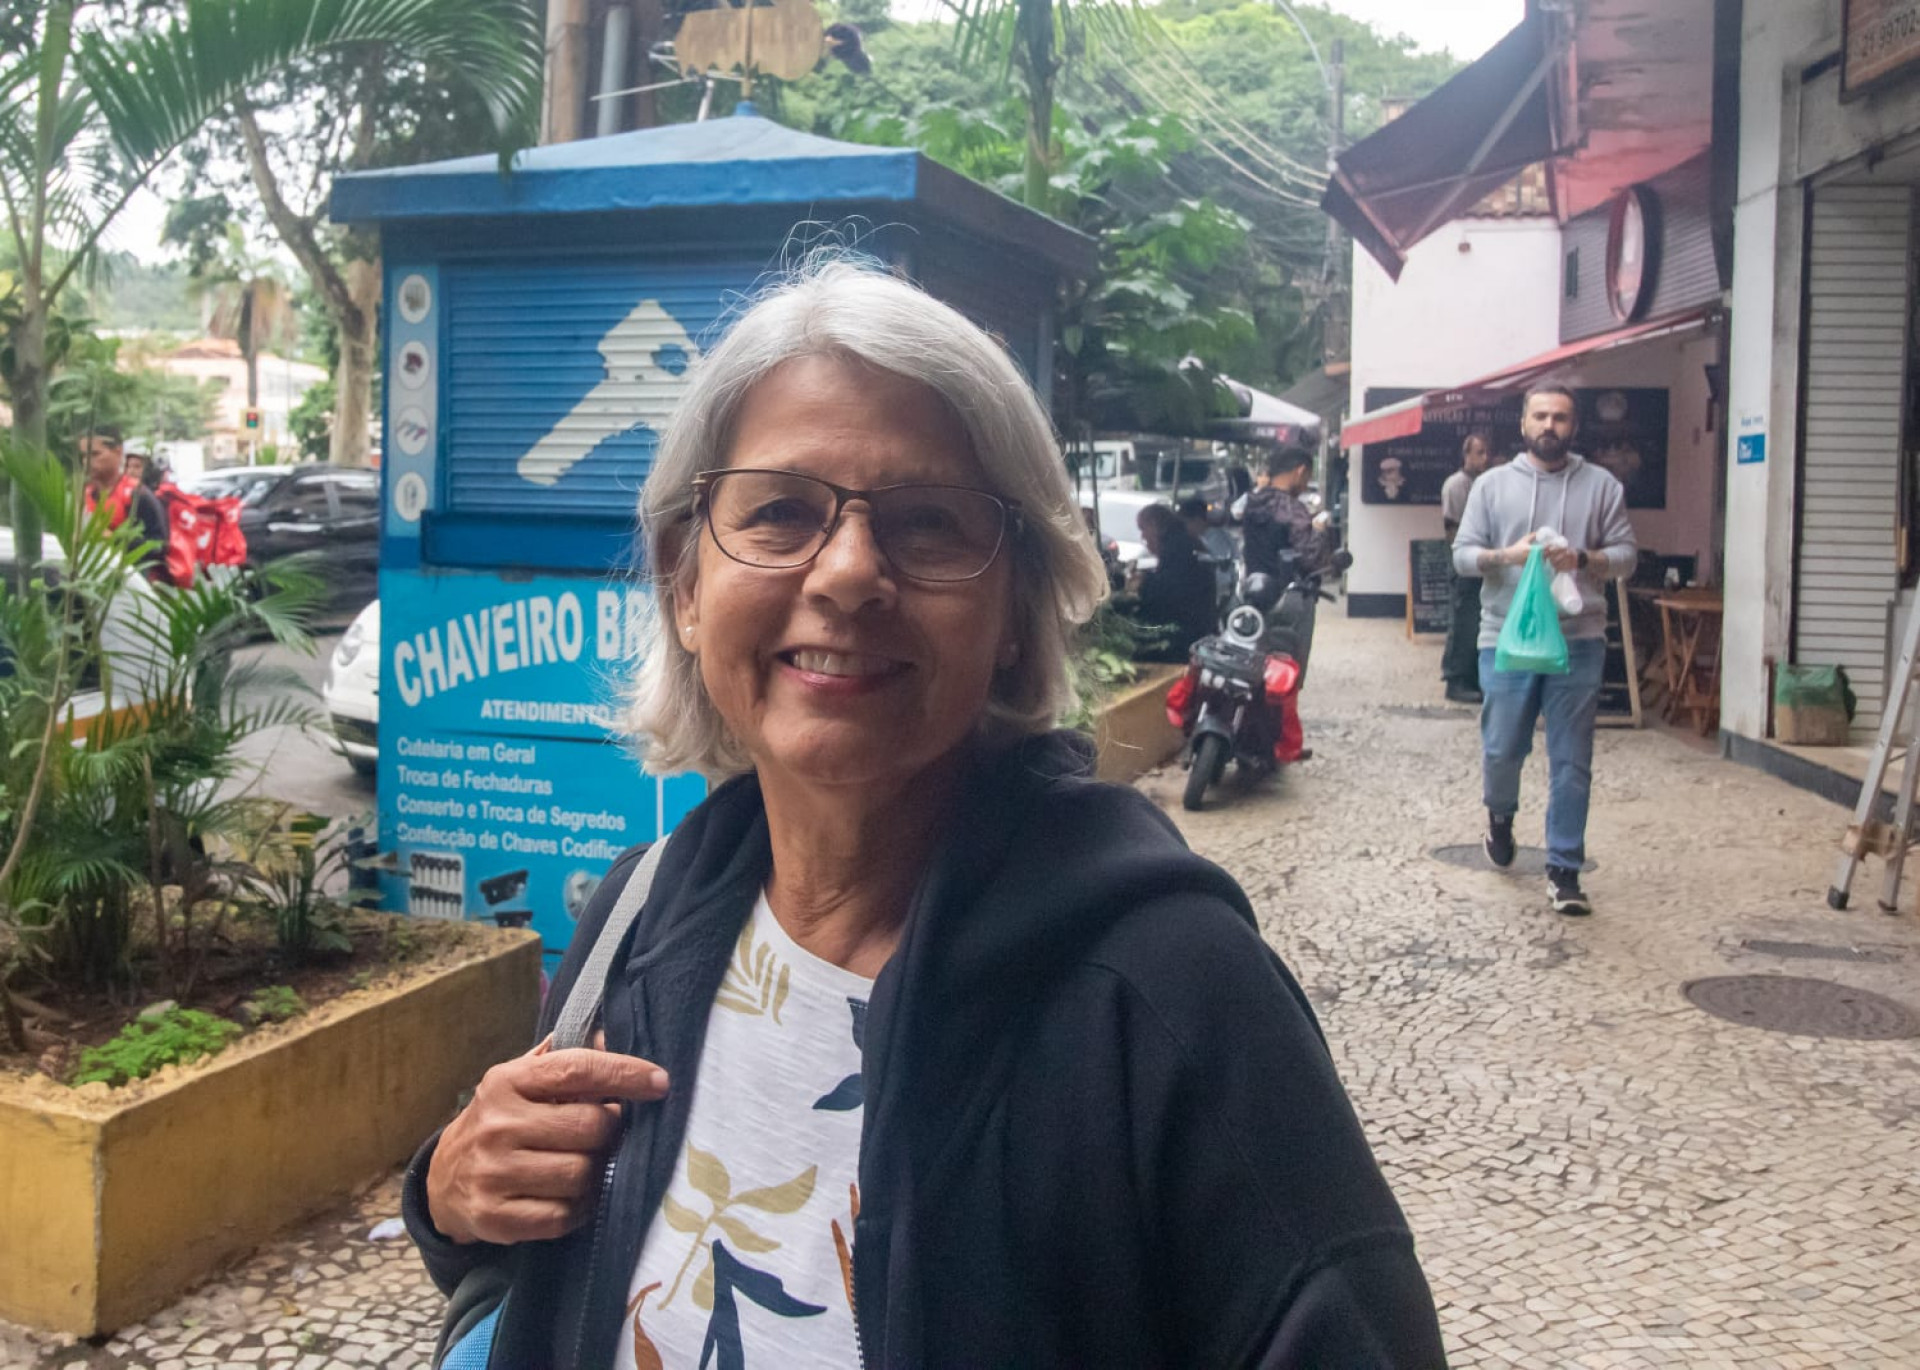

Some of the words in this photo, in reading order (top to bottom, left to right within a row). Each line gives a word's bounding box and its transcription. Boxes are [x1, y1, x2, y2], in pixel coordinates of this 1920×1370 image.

[394, 592, 583, 706] CHAVEIRO
[481, 699, 609, 724] ATENDIMENTO
[397, 737, 463, 759] Cutelaria
[467, 745, 490, 760] em
[494, 743, 535, 764] Geral
[397, 765, 438, 786] Troca
[442, 769, 460, 788] de
[464, 770, 552, 795] Fechaduras
[397, 793, 464, 817] Conserto
[467, 804, 476, 818] e
[480, 801, 523, 822] Troca
[527, 804, 546, 824] de
[550, 806, 626, 832] Segredos
[398, 822, 475, 851] Confecção
[479, 830, 498, 849] de
[502, 831, 558, 854] Chaves
